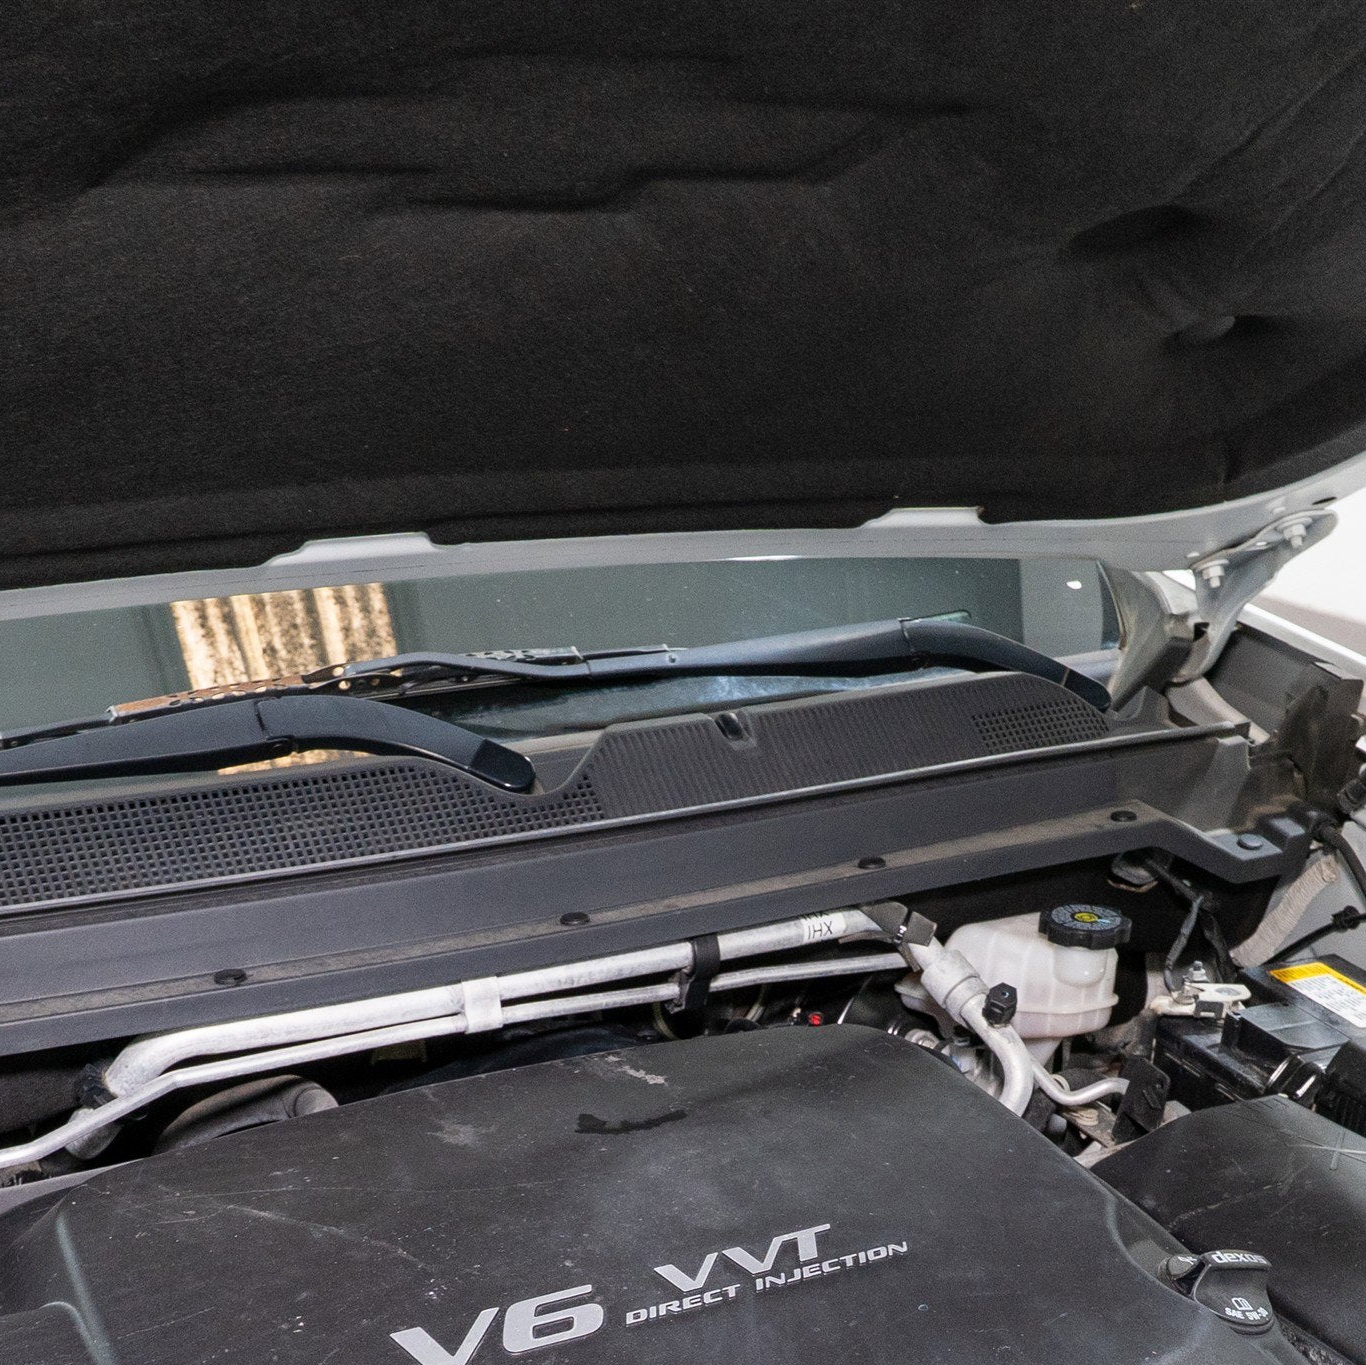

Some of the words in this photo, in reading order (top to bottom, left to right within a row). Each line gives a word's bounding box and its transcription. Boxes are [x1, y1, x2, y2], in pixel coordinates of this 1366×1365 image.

[625, 1283, 741, 1327] DIRECT
[755, 1240, 909, 1292] INJECTION
[653, 1223, 831, 1293] VVT
[1212, 1250, 1268, 1265] dexos
